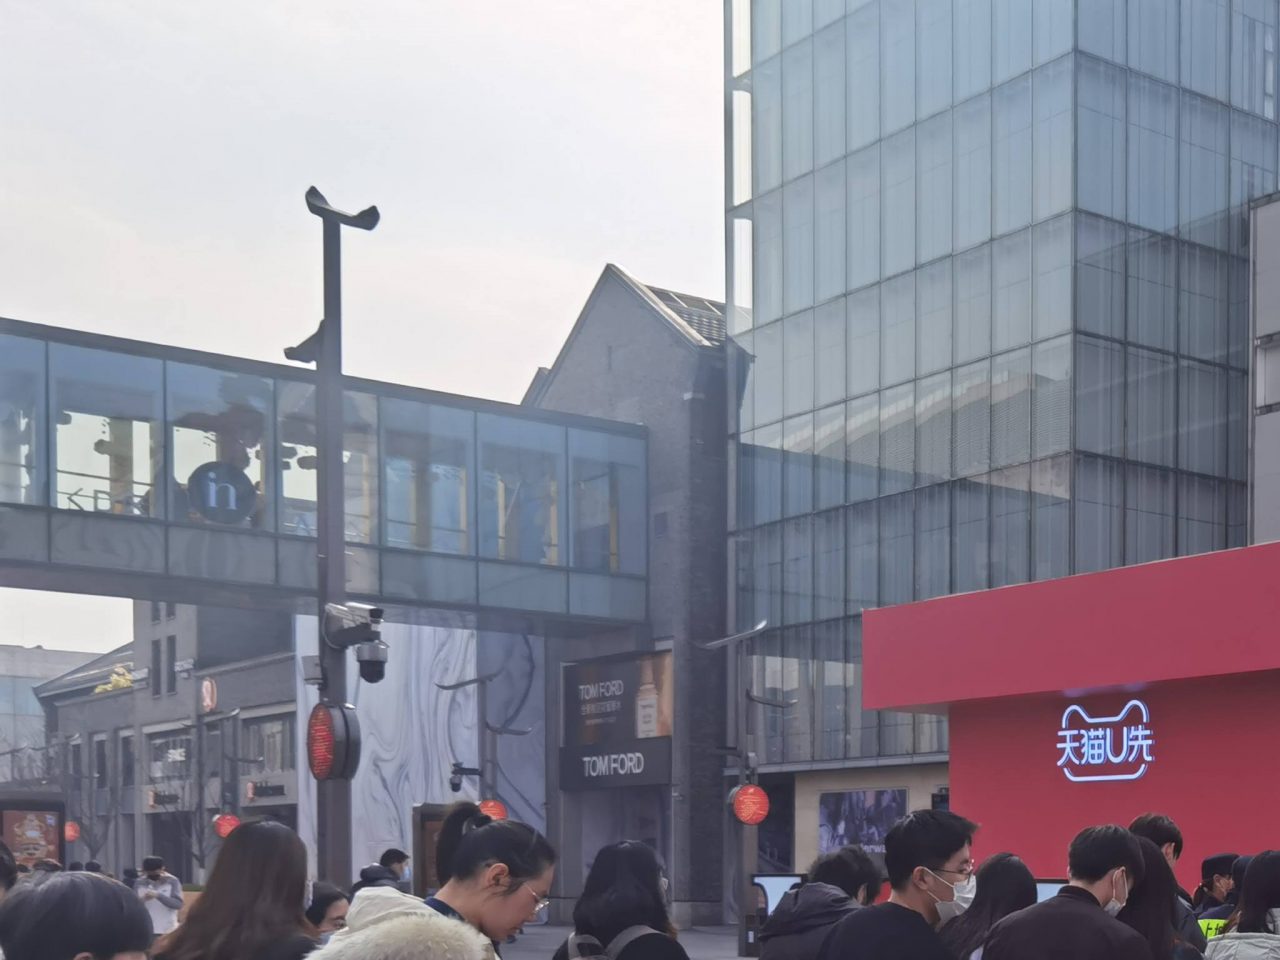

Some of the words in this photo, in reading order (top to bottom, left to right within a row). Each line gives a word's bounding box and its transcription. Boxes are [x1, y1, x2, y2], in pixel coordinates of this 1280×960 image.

[578, 683, 599, 700] TOM
[599, 679, 625, 698] FORD
[1056, 724, 1153, 767] 天猫U先
[582, 755, 609, 777] TOM
[610, 752, 645, 775] FORD
